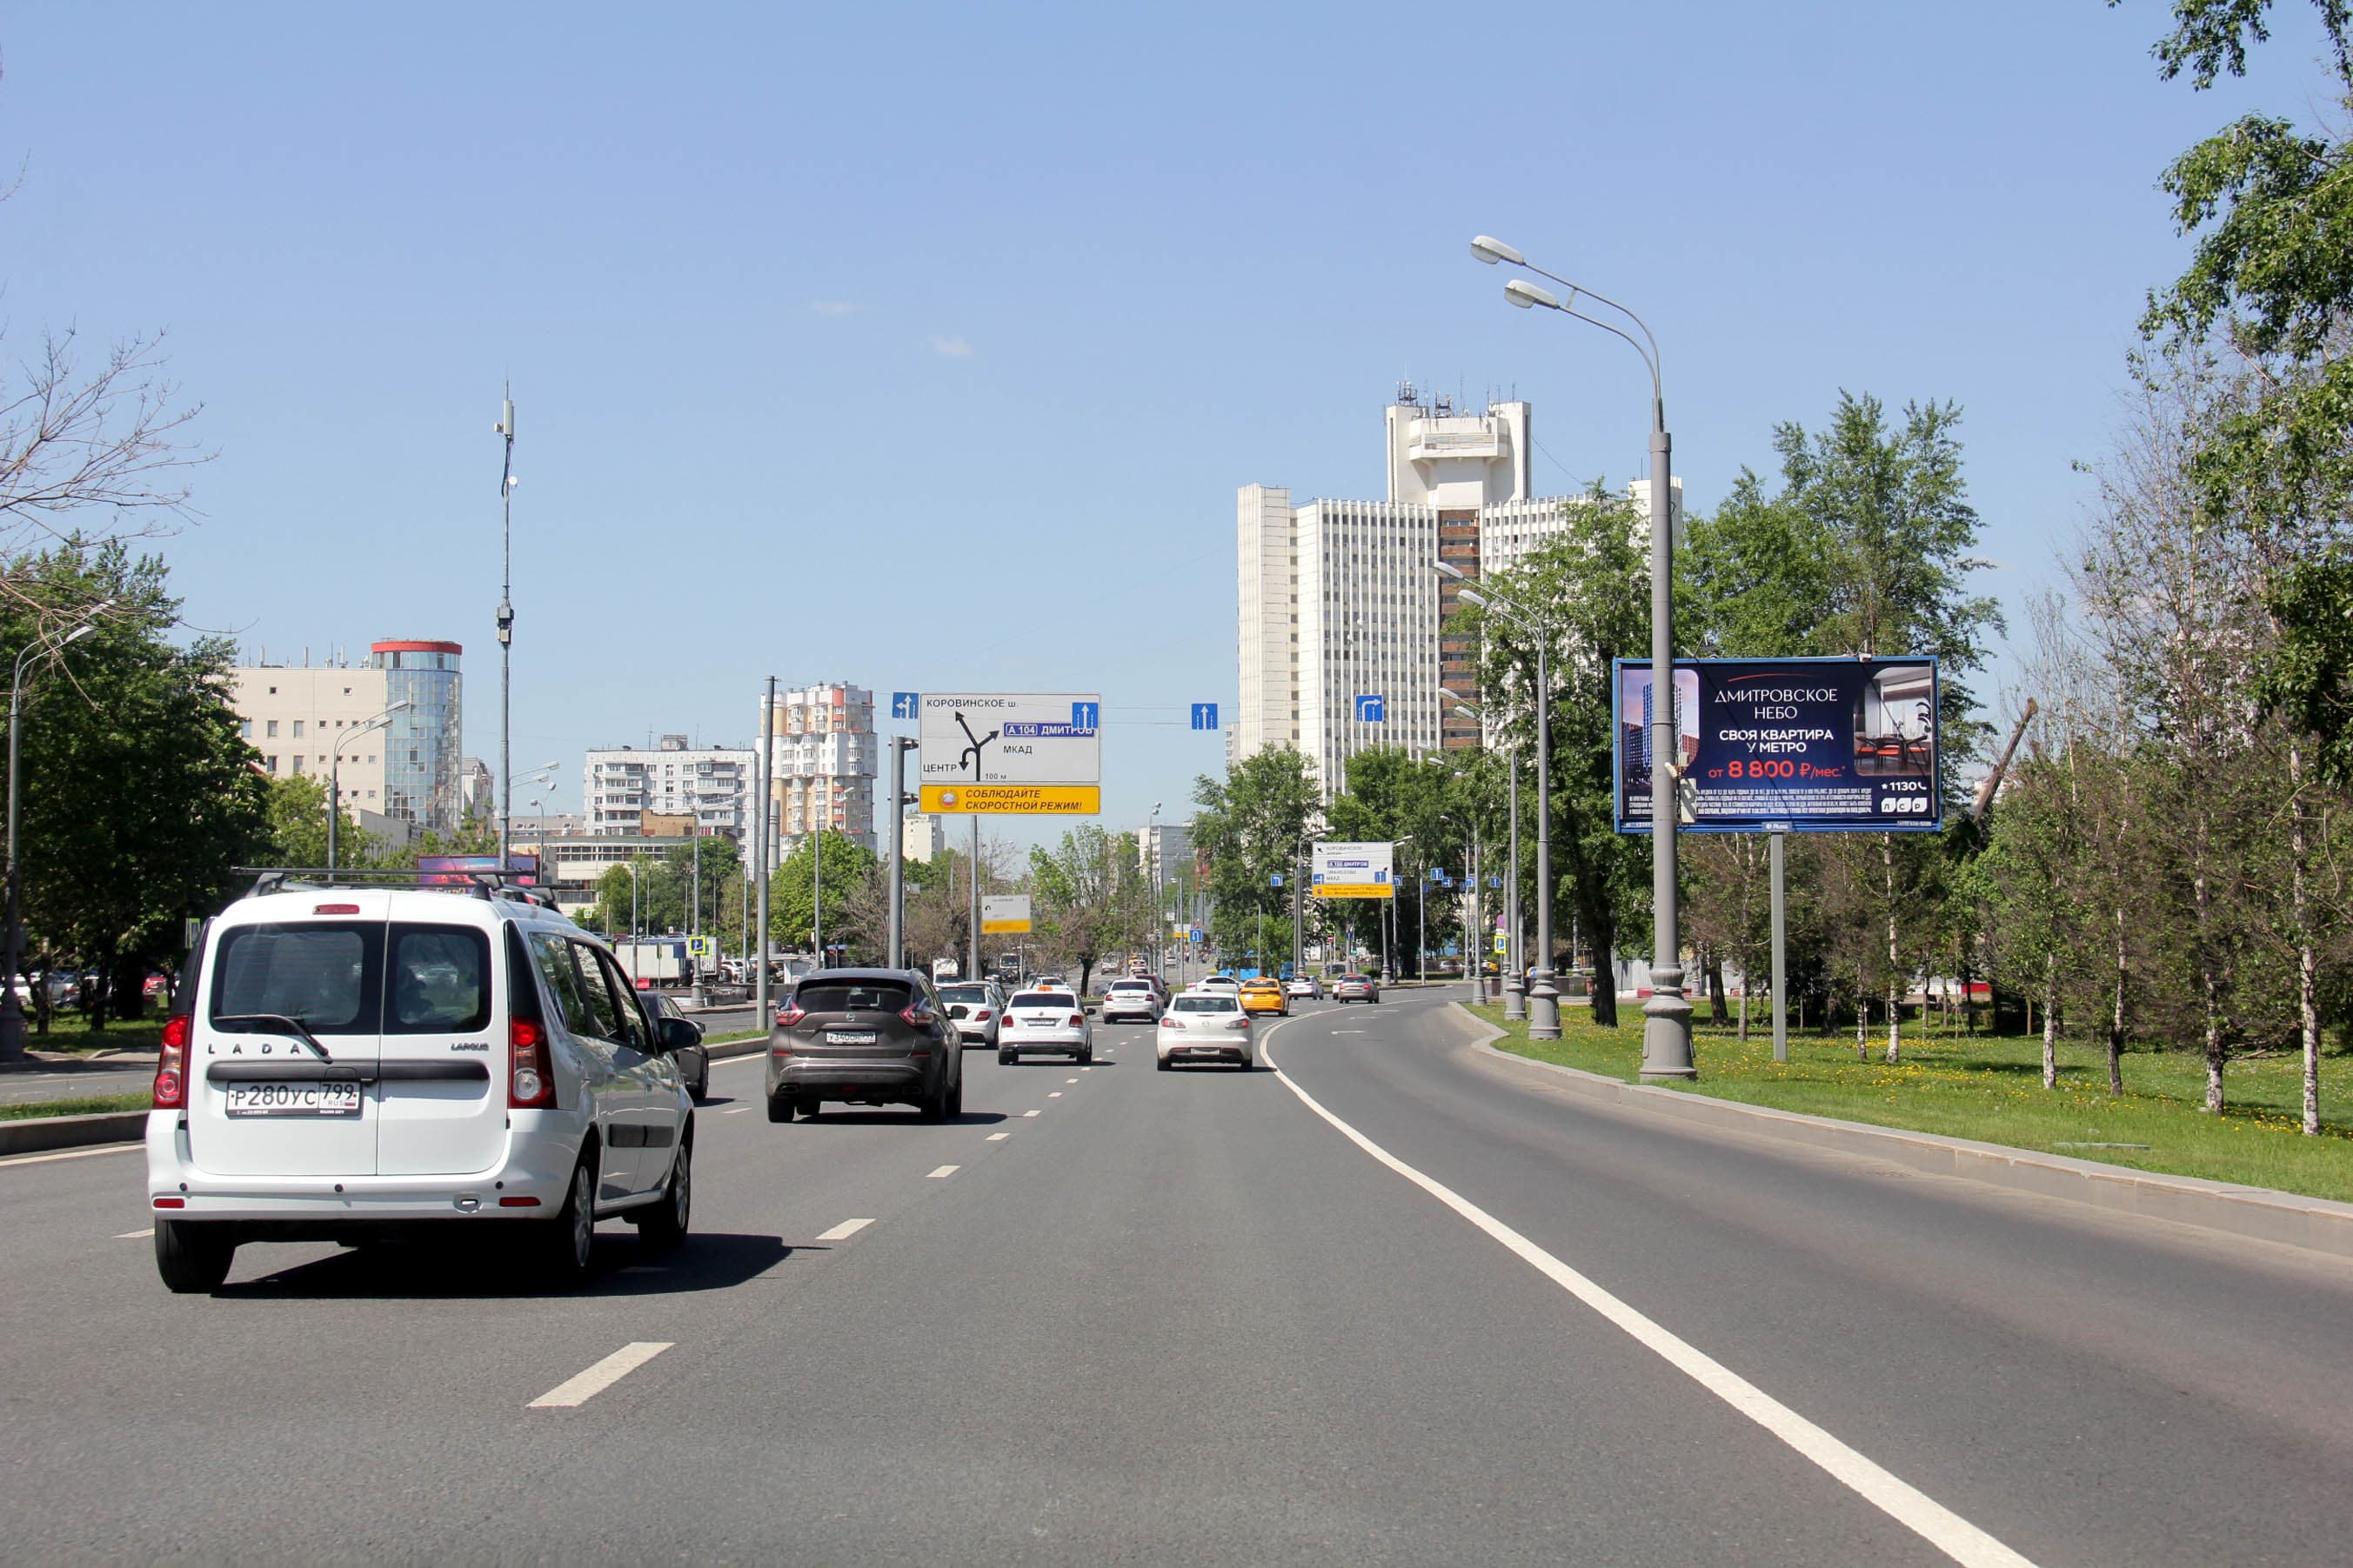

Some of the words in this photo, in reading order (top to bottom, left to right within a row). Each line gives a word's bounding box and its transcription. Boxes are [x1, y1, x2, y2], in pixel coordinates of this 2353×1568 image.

[1715, 689, 1838, 703] ДМИТРОВСКОЕ
[926, 698, 1005, 708] КОРОВИНСКОЕ
[1754, 706, 1798, 720] НЕБО
[1008, 725, 1016, 734] А
[1019, 725, 1035, 734] 104
[1719, 730, 1757, 741] СВОЯ
[1761, 729, 1835, 740] КВАРТИРА
[1003, 745, 1033, 755] МКАД
[1746, 742, 1756, 753] У
[1759, 742, 1807, 753] МЕТРО
[923, 764, 957, 773] ЦЕНТР
[1728, 759, 1743, 778] 8
[1748, 759, 1795, 778] 800
[966, 789, 1041, 799] СОБЛЮДАЙТЕ
[966, 800, 1037, 810] СКОРОСТНОЙ
[1039, 801, 1082, 811] РЕЖИМ!
[208, 1044, 301, 1054] LADA
